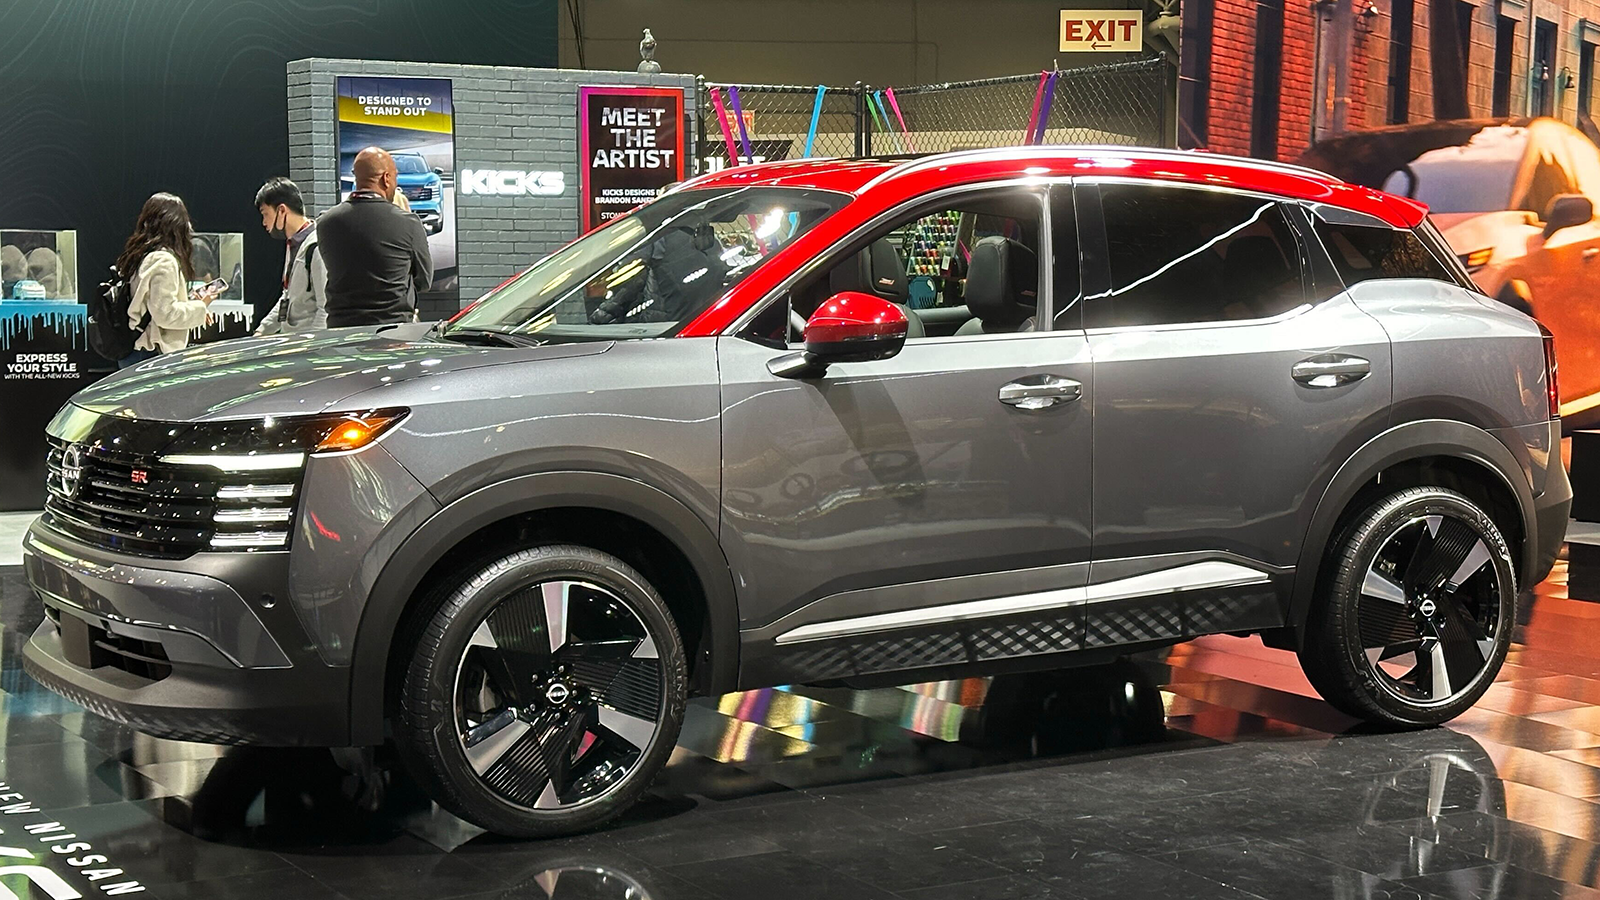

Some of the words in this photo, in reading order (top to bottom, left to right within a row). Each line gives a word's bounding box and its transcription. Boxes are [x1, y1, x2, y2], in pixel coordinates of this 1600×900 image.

[1065, 20, 1138, 42] EXIT
[358, 95, 414, 106] DESIGNED
[416, 97, 432, 106] TO
[364, 106, 401, 116] STAND
[403, 107, 427, 117] OUT
[601, 107, 666, 127] MEET
[610, 128, 657, 148] THE
[592, 149, 675, 169] ARTIST
[461, 168, 566, 196] KICKS
[594, 196, 631, 204] BRANDON
[602, 188, 624, 196] KICKS
[624, 188, 656, 197] DESIGNS
[15, 353, 69, 363] EXPRESS
[7, 363, 40, 373] YOUR
[41, 362, 77, 373] STYLE
[131, 469, 149, 484] SR
[0, 781, 41, 815] EW
[23, 821, 146, 896] NISSAN
